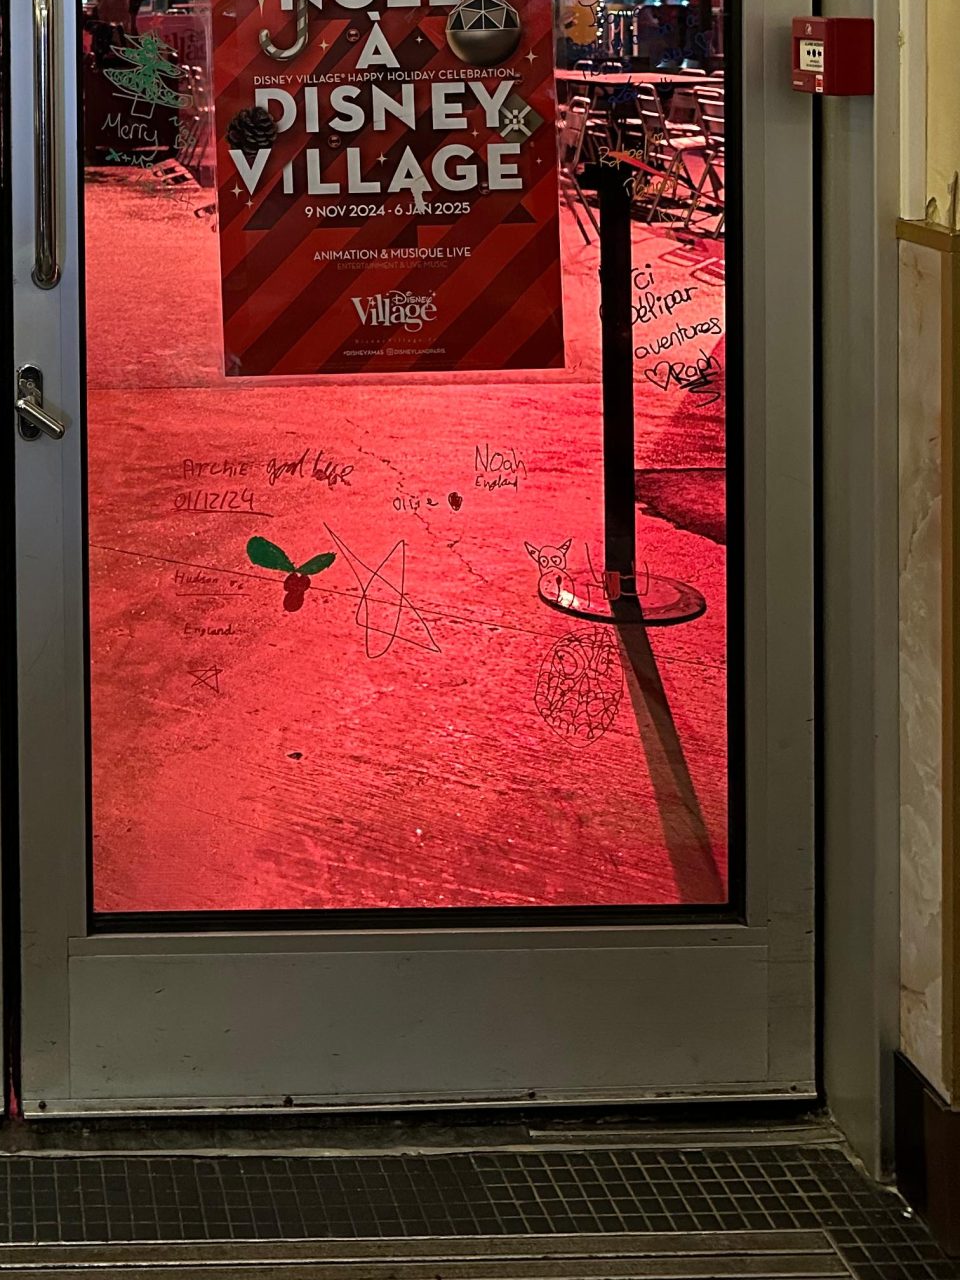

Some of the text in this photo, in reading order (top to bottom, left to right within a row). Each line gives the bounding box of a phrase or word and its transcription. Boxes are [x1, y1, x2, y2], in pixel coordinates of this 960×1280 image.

[355, 11, 400, 69] À
[254, 75, 294, 85] DISNEY
[348, 73, 385, 83] HAPPY
[387, 70, 436, 81] HOLIDAY
[254, 82, 515, 133] DISNEY
[101, 113, 158, 160] Merry
[228, 143, 523, 196] VILLAGE
[305, 206, 313, 218] 9
[316, 205, 348, 218] NOV
[349, 204, 386, 217] 2024
[394, 204, 403, 215] 6
[434, 201, 470, 214] 2025
[313, 249, 378, 261] ANIMATION
[391, 247, 444, 259] MUSIQUE
[446, 246, 471, 257] LIVE
[351, 292, 438, 332] Village
